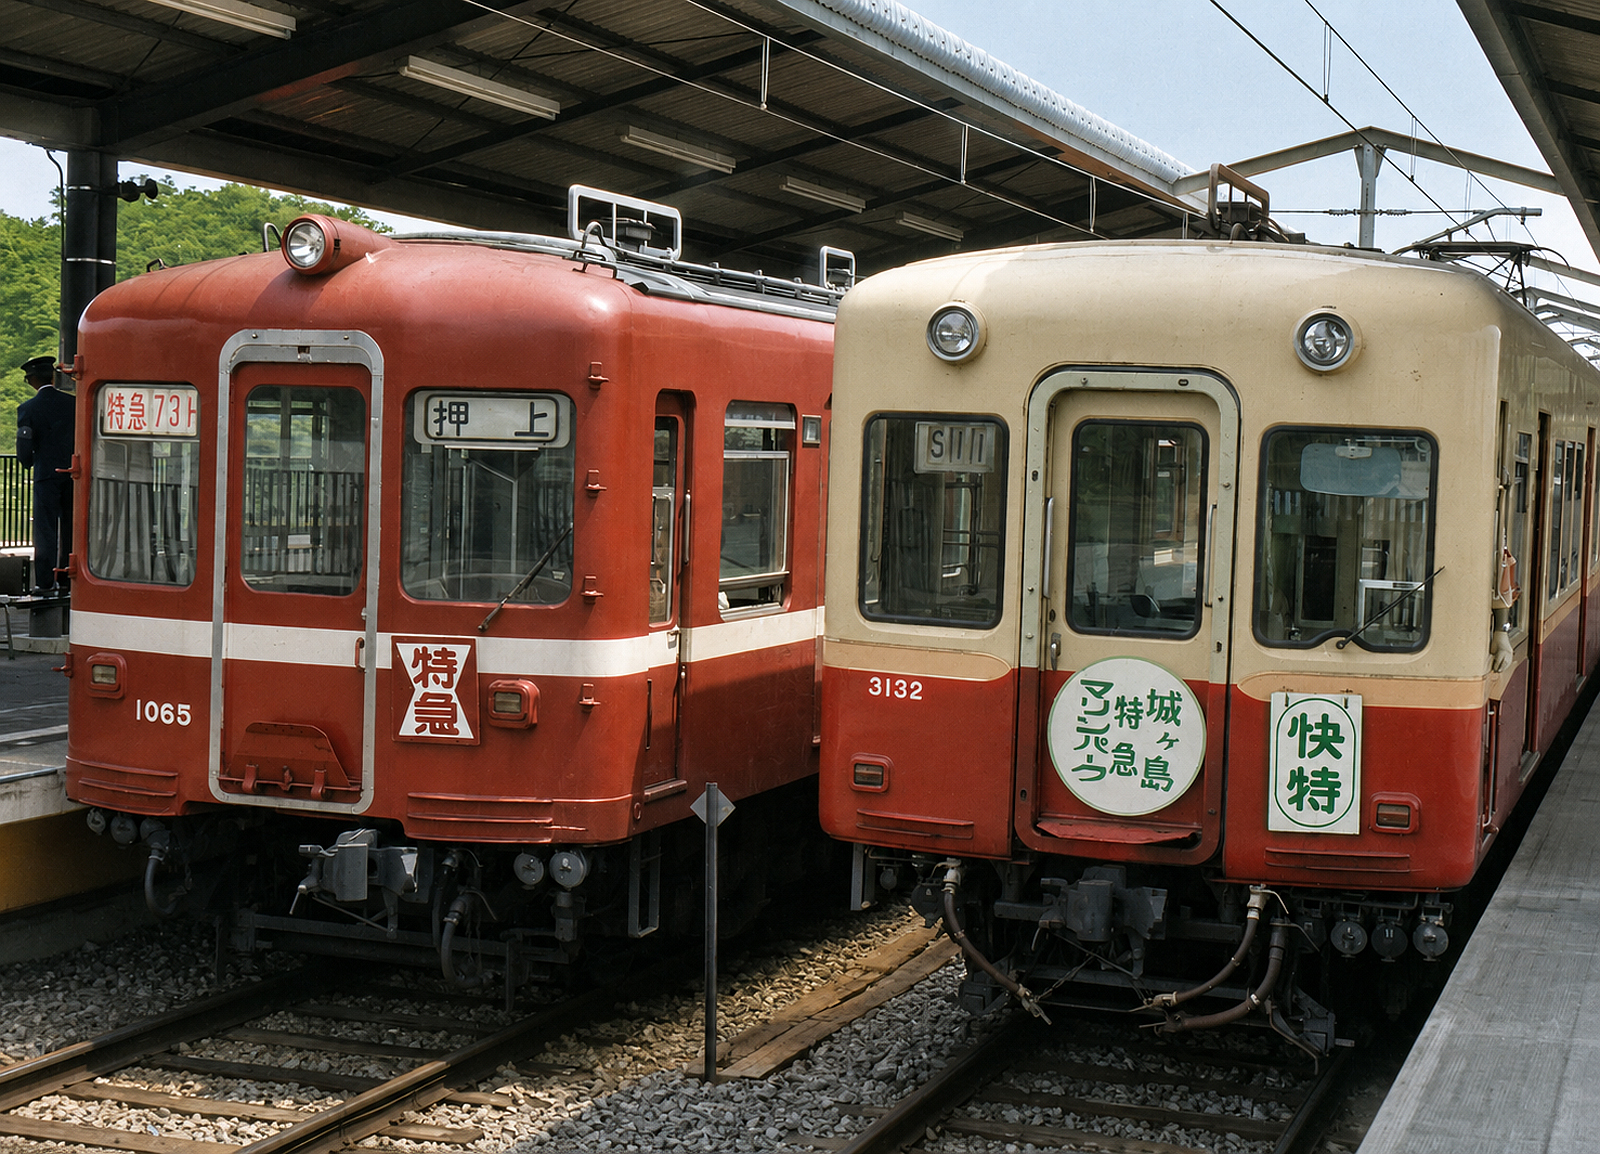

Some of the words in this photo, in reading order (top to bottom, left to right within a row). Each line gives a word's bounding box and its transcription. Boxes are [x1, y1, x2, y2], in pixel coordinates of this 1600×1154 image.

[433, 400, 550, 438] 押上
[136, 699, 192, 726] 1065
[411, 645, 460, 736] 特急
[868, 676, 923, 701] 3132
[1071, 679, 1114, 782] マリンパーク
[1108, 695, 1144, 777] 特急
[1286, 712, 1346, 815] 快特
